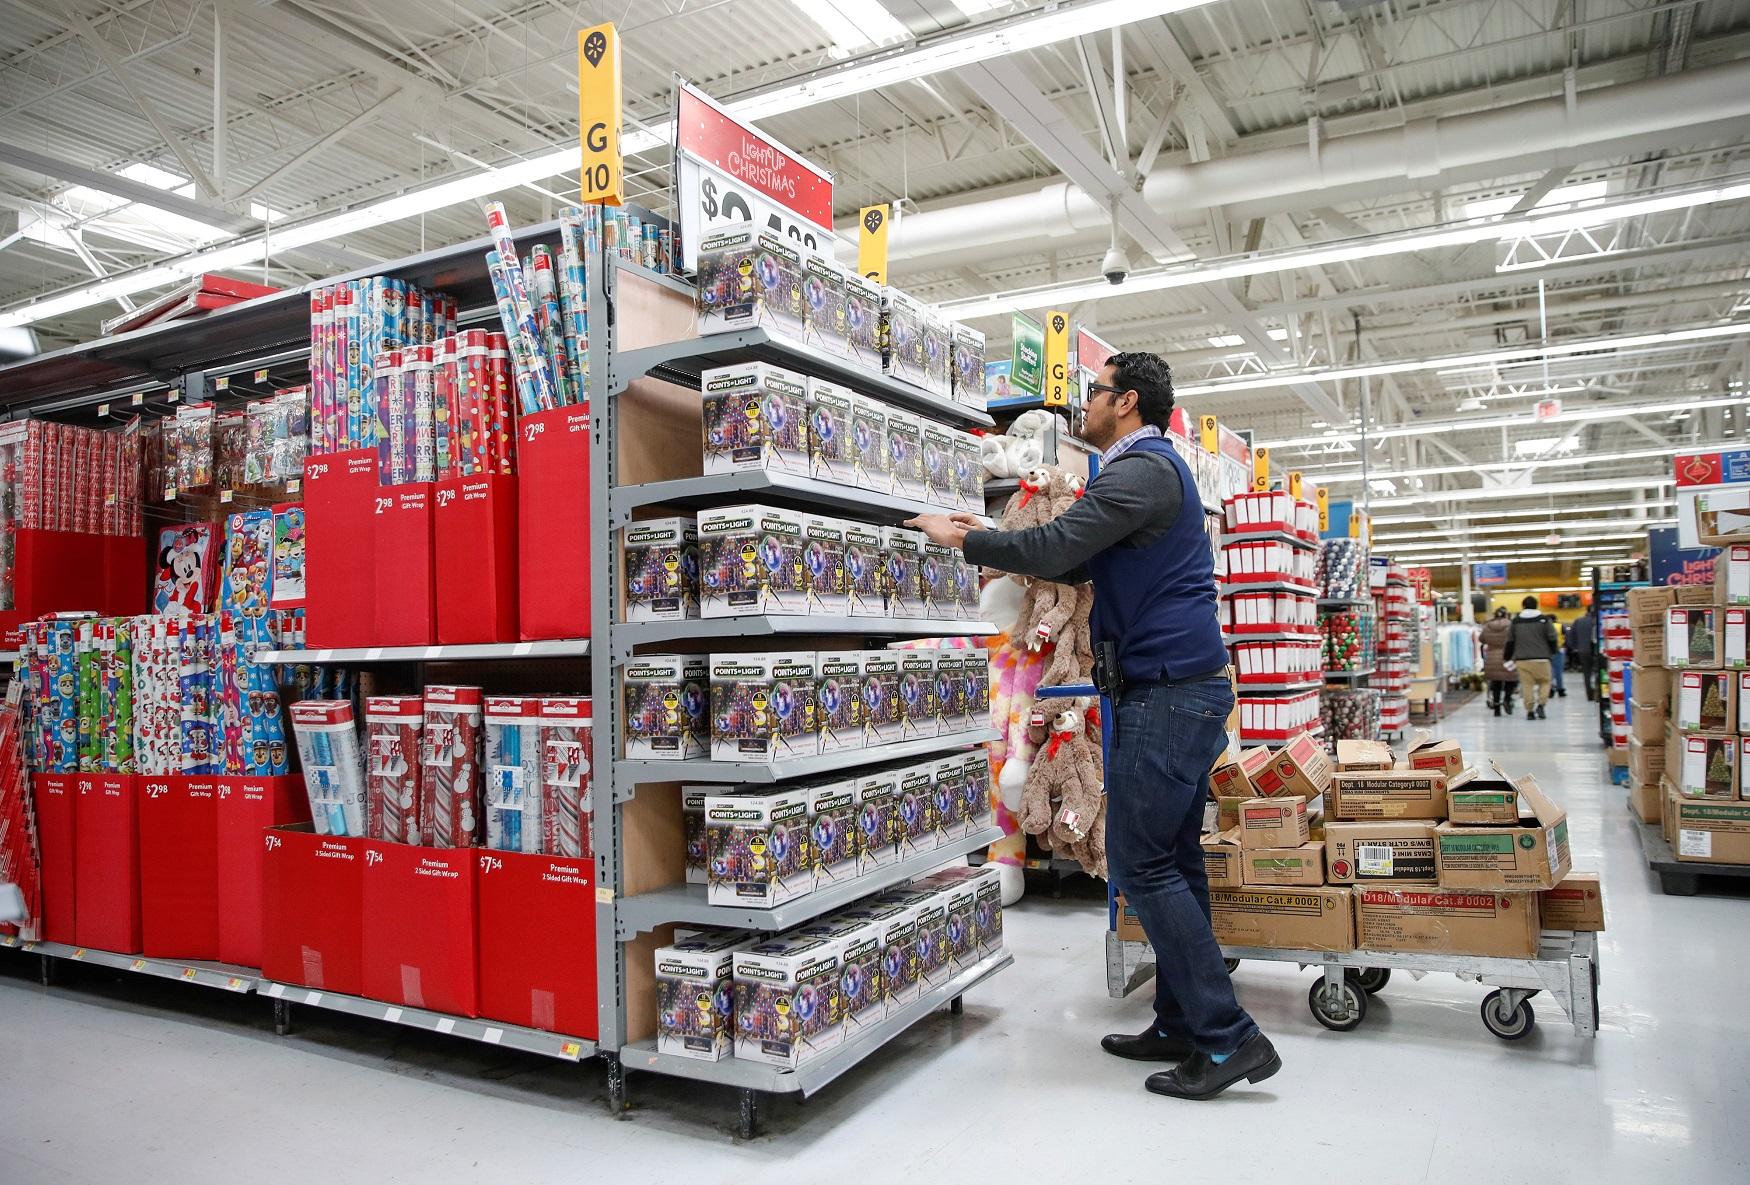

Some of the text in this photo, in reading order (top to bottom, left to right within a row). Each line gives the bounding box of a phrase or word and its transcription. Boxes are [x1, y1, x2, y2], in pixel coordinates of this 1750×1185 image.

[587, 123, 607, 152] G
[742, 136, 786, 171] LIGHT UP
[585, 163, 609, 192] 10
[728, 152, 795, 198] CHRISTMAS
[702, 236, 746, 250] POINTS LIGHT
[760, 239, 797, 261] POINTS LIGHT
[808, 261, 842, 282] POINTS LIGHT
[1053, 364, 1063, 379] G
[708, 377, 752, 390] POINTS LIGHT
[766, 380, 802, 396] POINTS LIGHT
[1054, 386, 1061, 400] 8
[816, 394, 849, 409] POINTS LIGHT
[568, 413, 590, 424] Premiu
[348, 457, 372, 466] Premium
[359, 466, 370, 474] Wrap
[462, 482, 488, 492] Premium
[1257, 477, 1265, 486] G
[400, 492, 425, 501] Premium
[474, 492, 486, 500] Wrap
[411, 502, 424, 510] Wrap
[703, 524, 726, 532] POINTS
[763, 521, 800, 534] POINTS LIGHT
[808, 528, 840, 540] POINTS LIGHT
[1667, 573, 1715, 586] CHRIS
[774, 667, 811, 677] POINTS LIGHT
[824, 665, 842, 674] POINTS
[816, 796, 851, 810] POINTS LIGHT
[772, 805, 805, 819] POINTS LIGHT
[322, 842, 347, 851] Premium
[341, 853, 354, 861] Wrap
[422, 859, 448, 868] Premium
[550, 864, 579, 874] Premium
[441, 870, 459, 879] Wrap
[572, 877, 588, 886] Wrap
[1211, 893, 1318, 906] 18/Modular Cat.# 0002
[1364, 894, 1493, 906] D18/Modular Cat.# 0002
[845, 941, 876, 960] POINTS LIGHT
[739, 967, 783, 979] POINTS LIGHT
[797, 958, 835, 980] POINTS LIGHT
